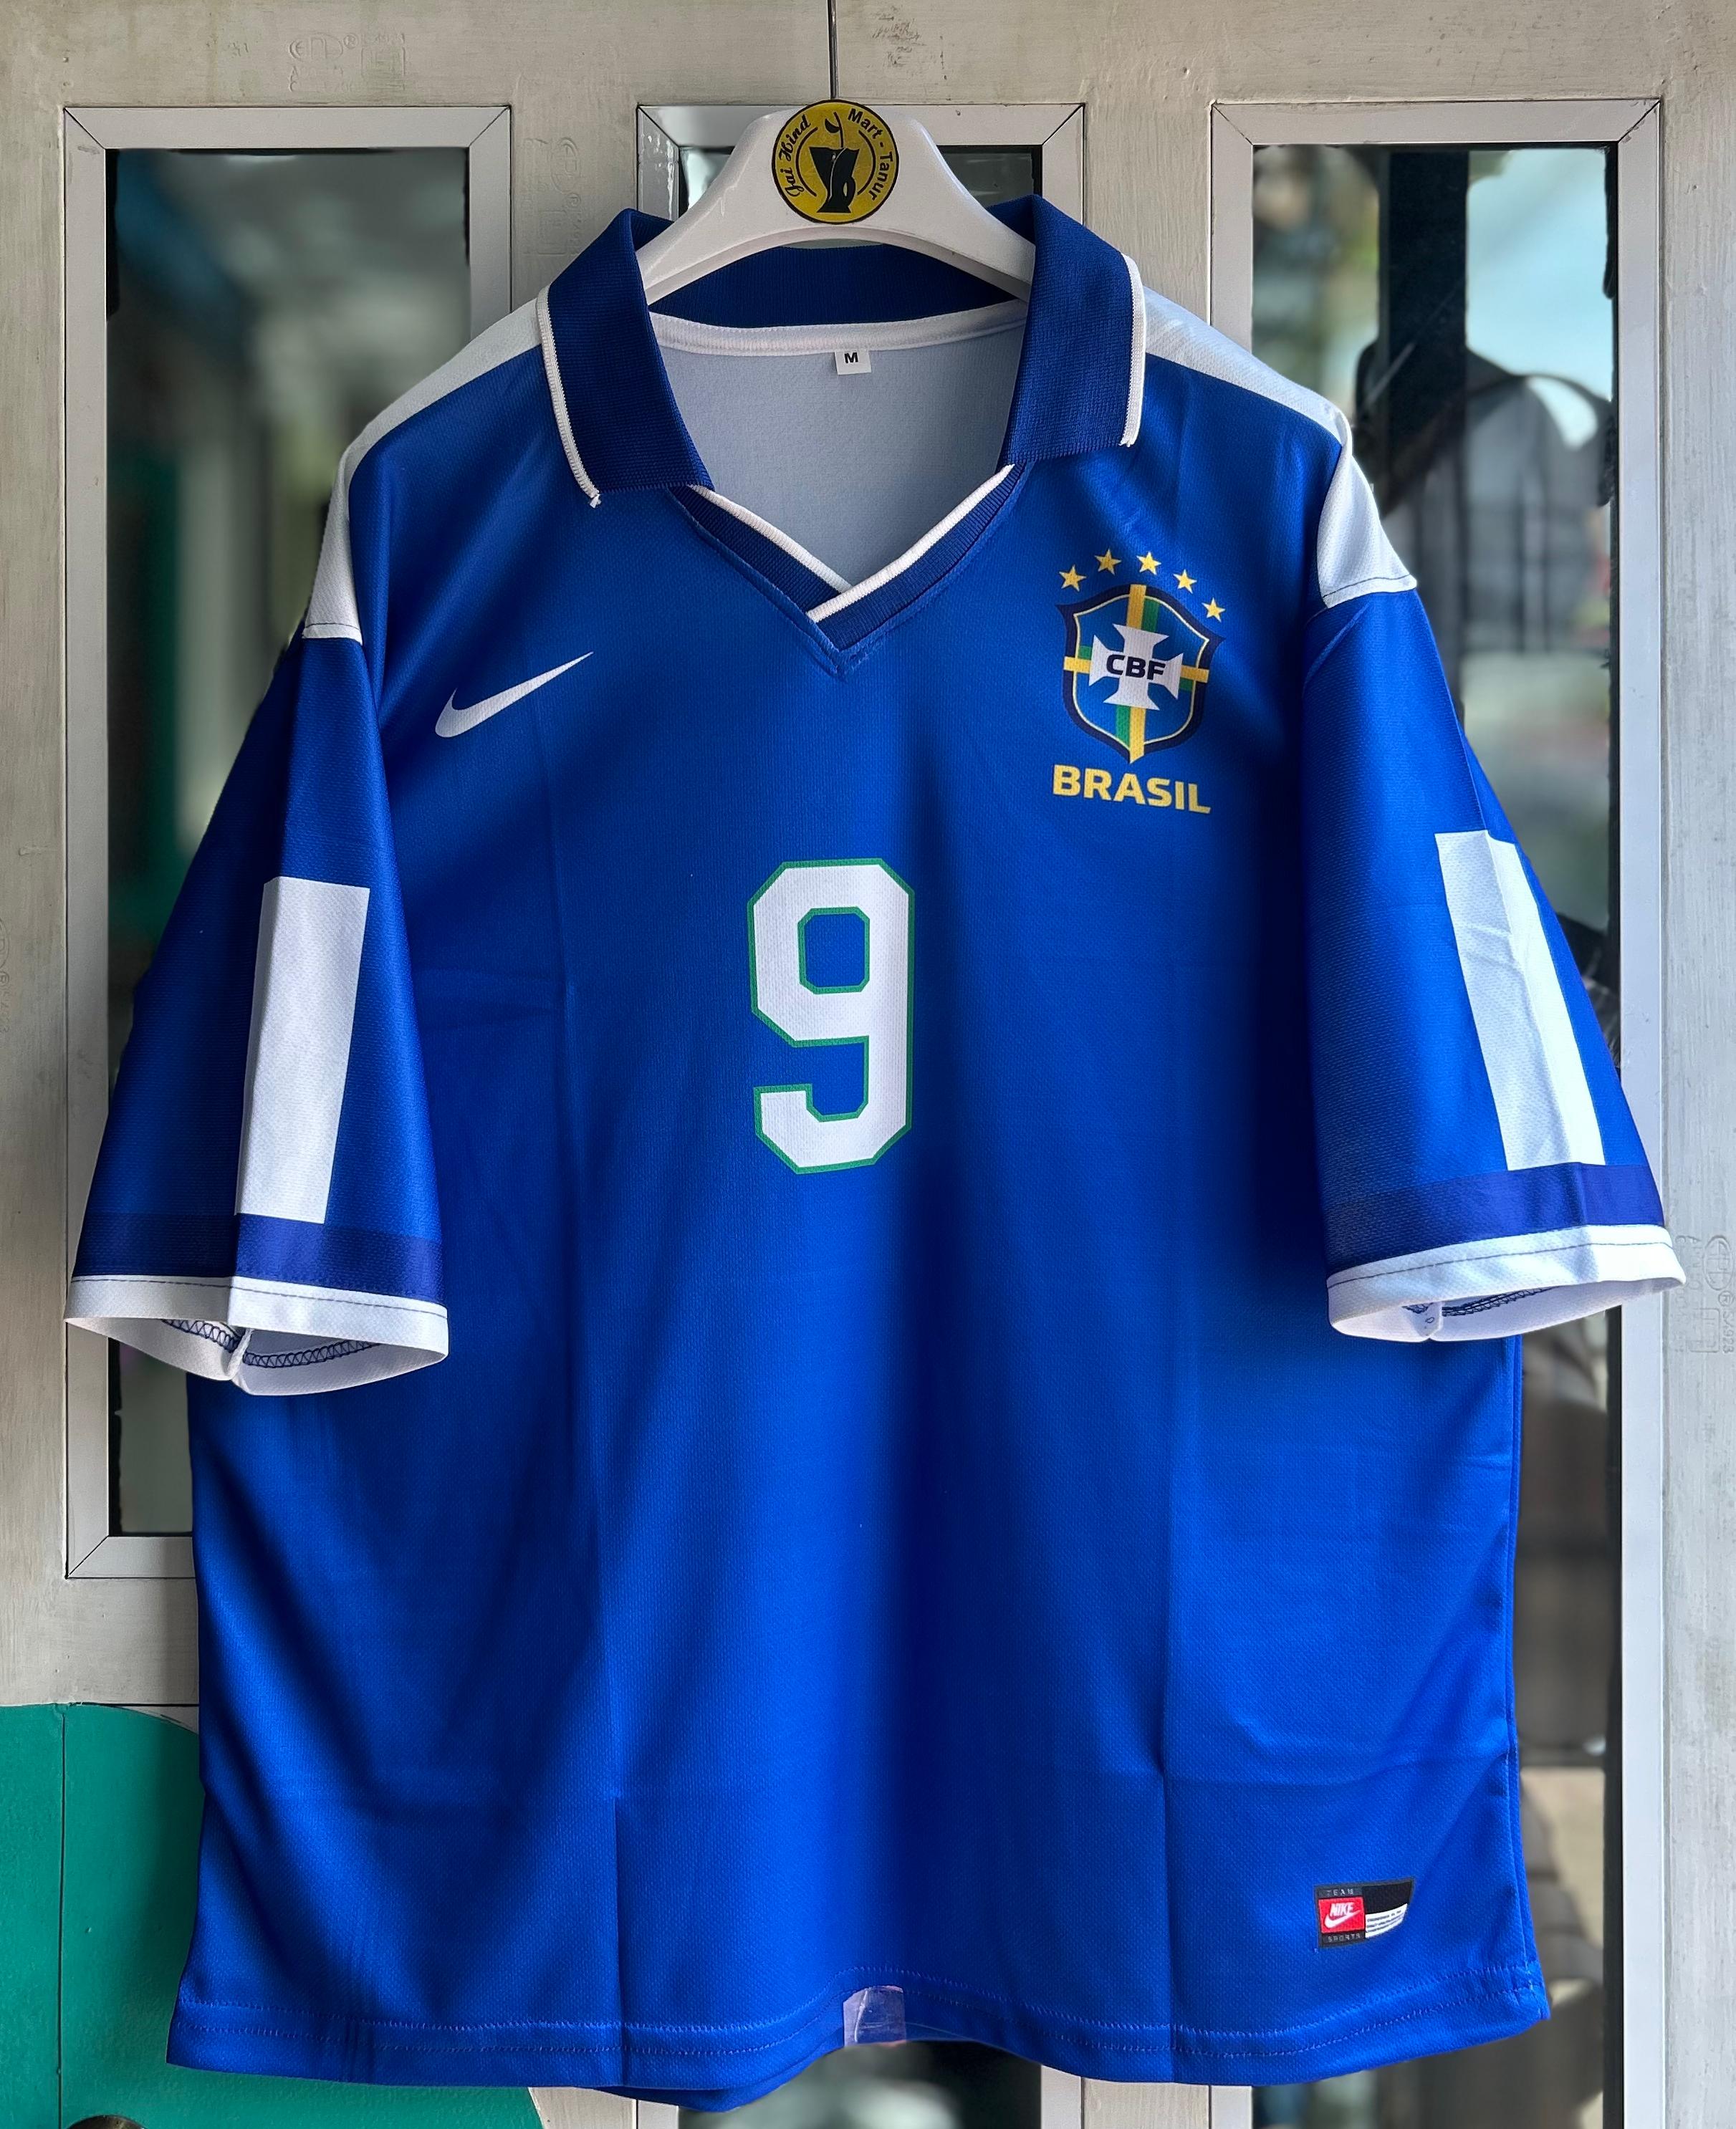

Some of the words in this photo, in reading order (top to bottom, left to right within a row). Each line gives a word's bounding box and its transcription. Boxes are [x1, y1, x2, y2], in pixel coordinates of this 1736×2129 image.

[778, 114, 812, 162] Hind
[848, 108, 883, 139] Mart
[780, 168, 805, 197] Jai
[868, 151, 893, 201] Tanur
[844, 352, 858, 364] M
[1106, 653, 1166, 681] CBF
[1052, 764, 1212, 814] BRASIL
[747, 858, 915, 1174] 9
[1326, 1888, 1353, 1897] TEAM
[1330, 1902, 1355, 1917] NIKE
[1328, 1933, 1361, 1943] SPORTS
